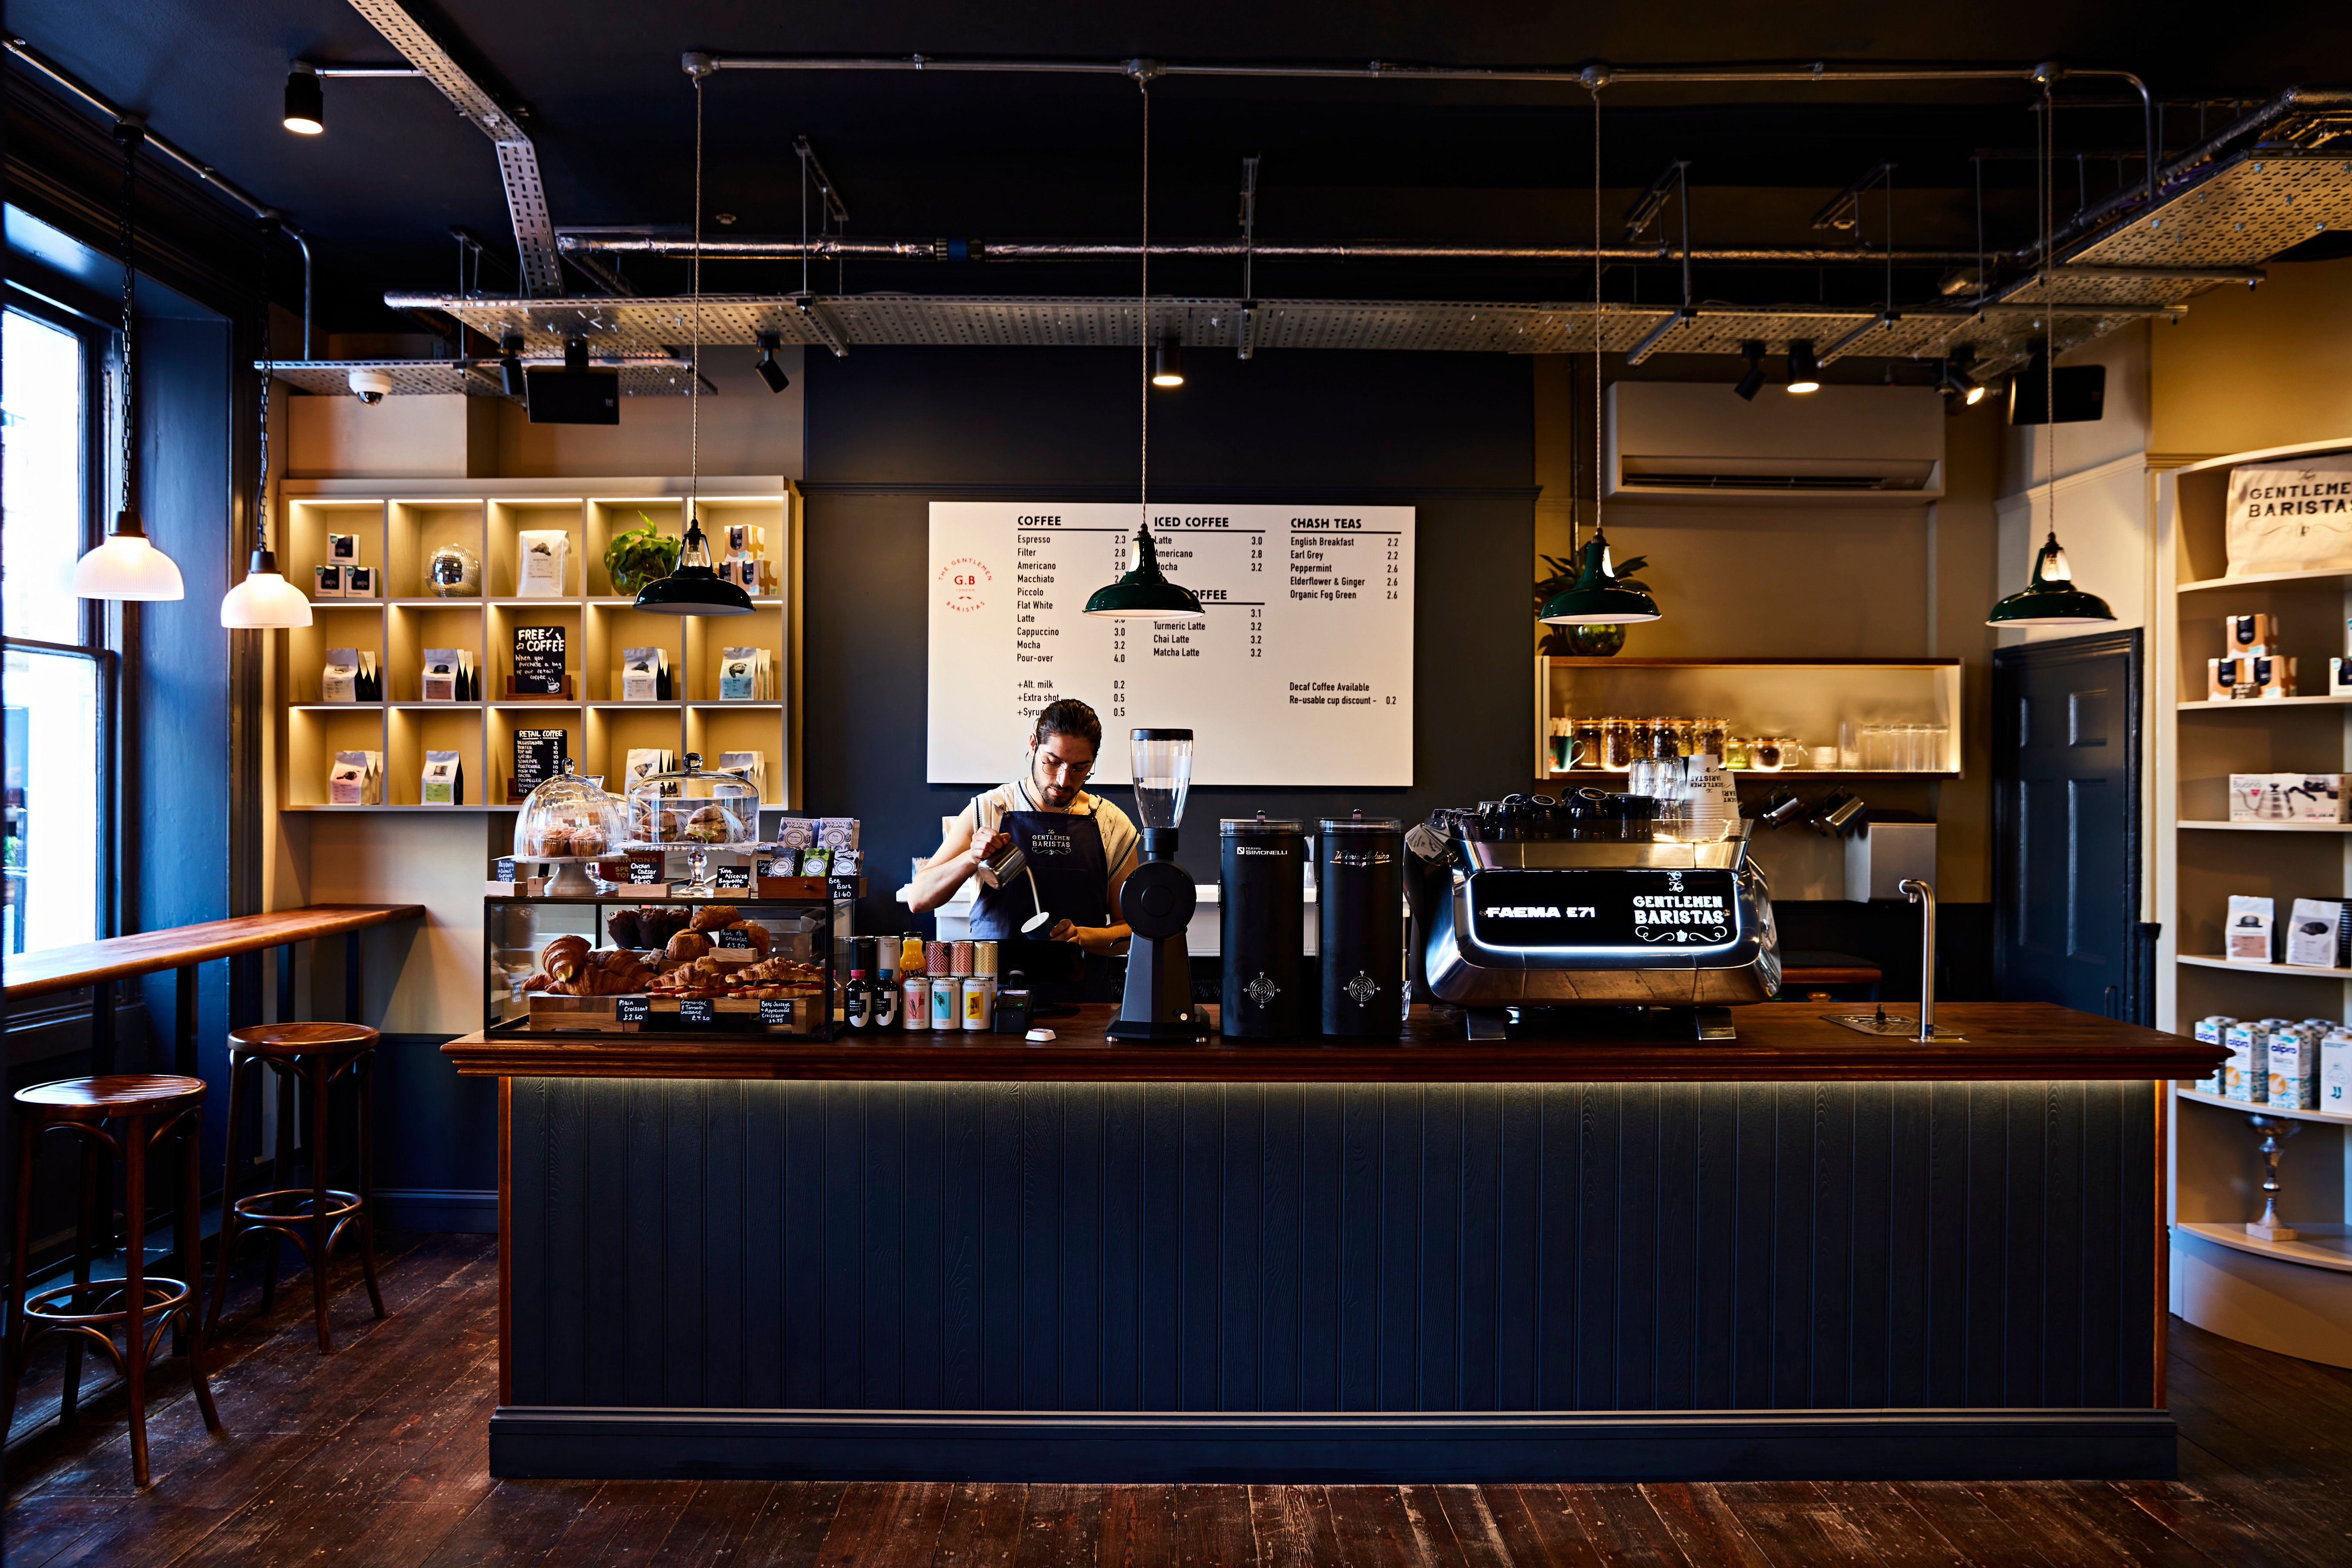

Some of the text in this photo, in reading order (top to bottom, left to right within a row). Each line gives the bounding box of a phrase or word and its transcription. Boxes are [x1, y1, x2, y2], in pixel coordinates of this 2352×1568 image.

[2250, 482, 2352, 499] GENTLEME
[1017, 516, 1061, 526] COFFEE
[1155, 517, 1229, 527] ICED COFFEE
[1291, 518, 1362, 529] CHASH TEAS
[1018, 534, 1050, 545] Espresso
[1115, 535, 1125, 544] 2.3
[1154, 536, 1172, 544] Latte
[1251, 536, 1262, 545] 3.0
[1291, 537, 1354, 548] English Breakfast
[1388, 538, 1398, 547] 2.2
[1018, 548, 1036, 556] Filter
[1115, 548, 1125, 557] 2.8
[1155, 549, 1193, 558] Americano
[1251, 549, 1262, 558] 2.8
[1291, 550, 1324, 561] Earl Grey
[1387, 551, 1398, 560] 2.2
[939, 558, 992, 581] THE GENTLEMEN
[1017, 561, 1056, 570] Americano
[1115, 561, 1125, 570] 2.8
[1251, 563, 1262, 571] 3.2
[1291, 563, 1332, 574] Peppermint
[1387, 564, 1398, 573] 2.6
[1017, 574, 1054, 583] Macchiato
[1291, 576, 1332, 585] Elderflower
[1342, 577, 1365, 588] Ginger
[1387, 578, 1398, 586] 2.6
[1017, 588, 1044, 596] Piccolo
[1290, 589, 1356, 601] Organic Fog Green
[1387, 591, 1398, 599] 2.6
[946, 601, 984, 612] BARISTAS
[1017, 601, 1053, 609] Flat White
[1251, 608, 1261, 618] 3.1
[1017, 614, 1035, 622] Latte
[1153, 621, 1206, 630] Turmeric Latte
[1251, 622, 1262, 631] 3.2
[518, 629, 545, 641] FREE
[1017, 627, 1059, 638] Cappuccino
[1114, 628, 1125, 636] 3.0
[1154, 634, 1190, 643] Chai Latte
[1250, 635, 1261, 644] 3.2
[527, 640, 565, 652] COFFEE
[1017, 640, 1040, 649] Mocha
[1114, 641, 1125, 649] 3.2
[1154, 648, 1200, 656] Matcha Latte
[1250, 648, 1261, 657] 3.2
[1017, 653, 1053, 662] Pour-over
[1114, 654, 1125, 662] 4.0
[1037, 680, 1053, 688] milk
[1114, 680, 1125, 689] 0.2
[1290, 682, 1369, 691] Decaf Coffee Available
[1114, 693, 1125, 702] 0.5
[1290, 695, 1371, 706] Re-usable cup discount
[1386, 696, 1396, 705] 0.2
[1114, 707, 1125, 716] 0.5
[1633, 896, 1723, 908] GENTLEMEN
[1486, 907, 1595, 918] FAEMA E71
[1634, 910, 1724, 924] BARISTAS
